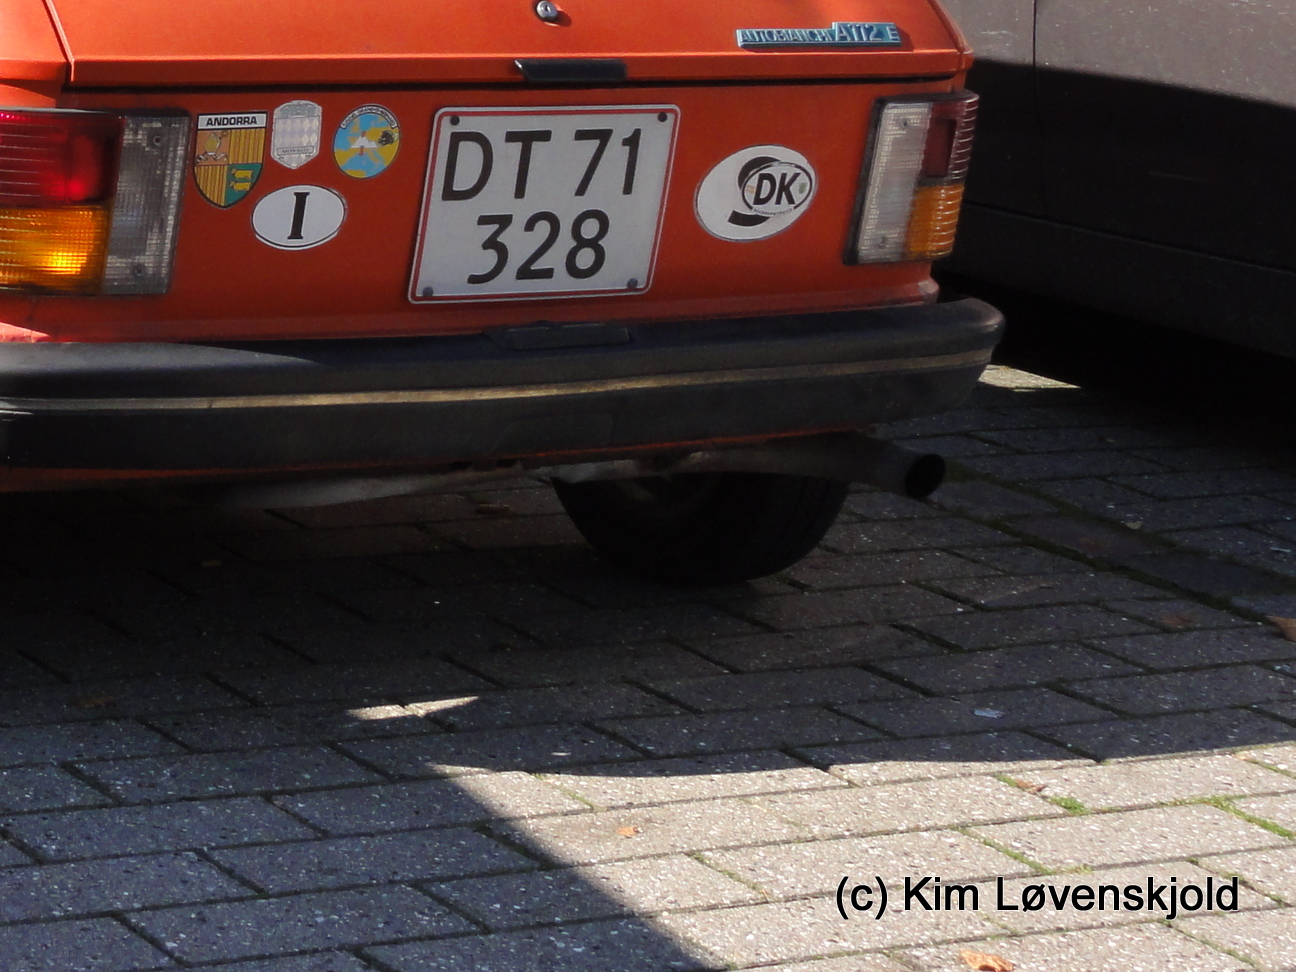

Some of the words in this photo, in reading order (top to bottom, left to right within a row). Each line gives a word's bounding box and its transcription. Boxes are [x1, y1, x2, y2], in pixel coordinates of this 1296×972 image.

[739, 28, 834, 44] AUTOBIANCHI
[834, 23, 883, 43] A112
[205, 115, 259, 127] ANDORRA
[441, 129, 552, 201] DT
[574, 128, 642, 196] 71
[752, 172, 802, 206] DK
[287, 191, 311, 240] I
[467, 209, 610, 285] 328
